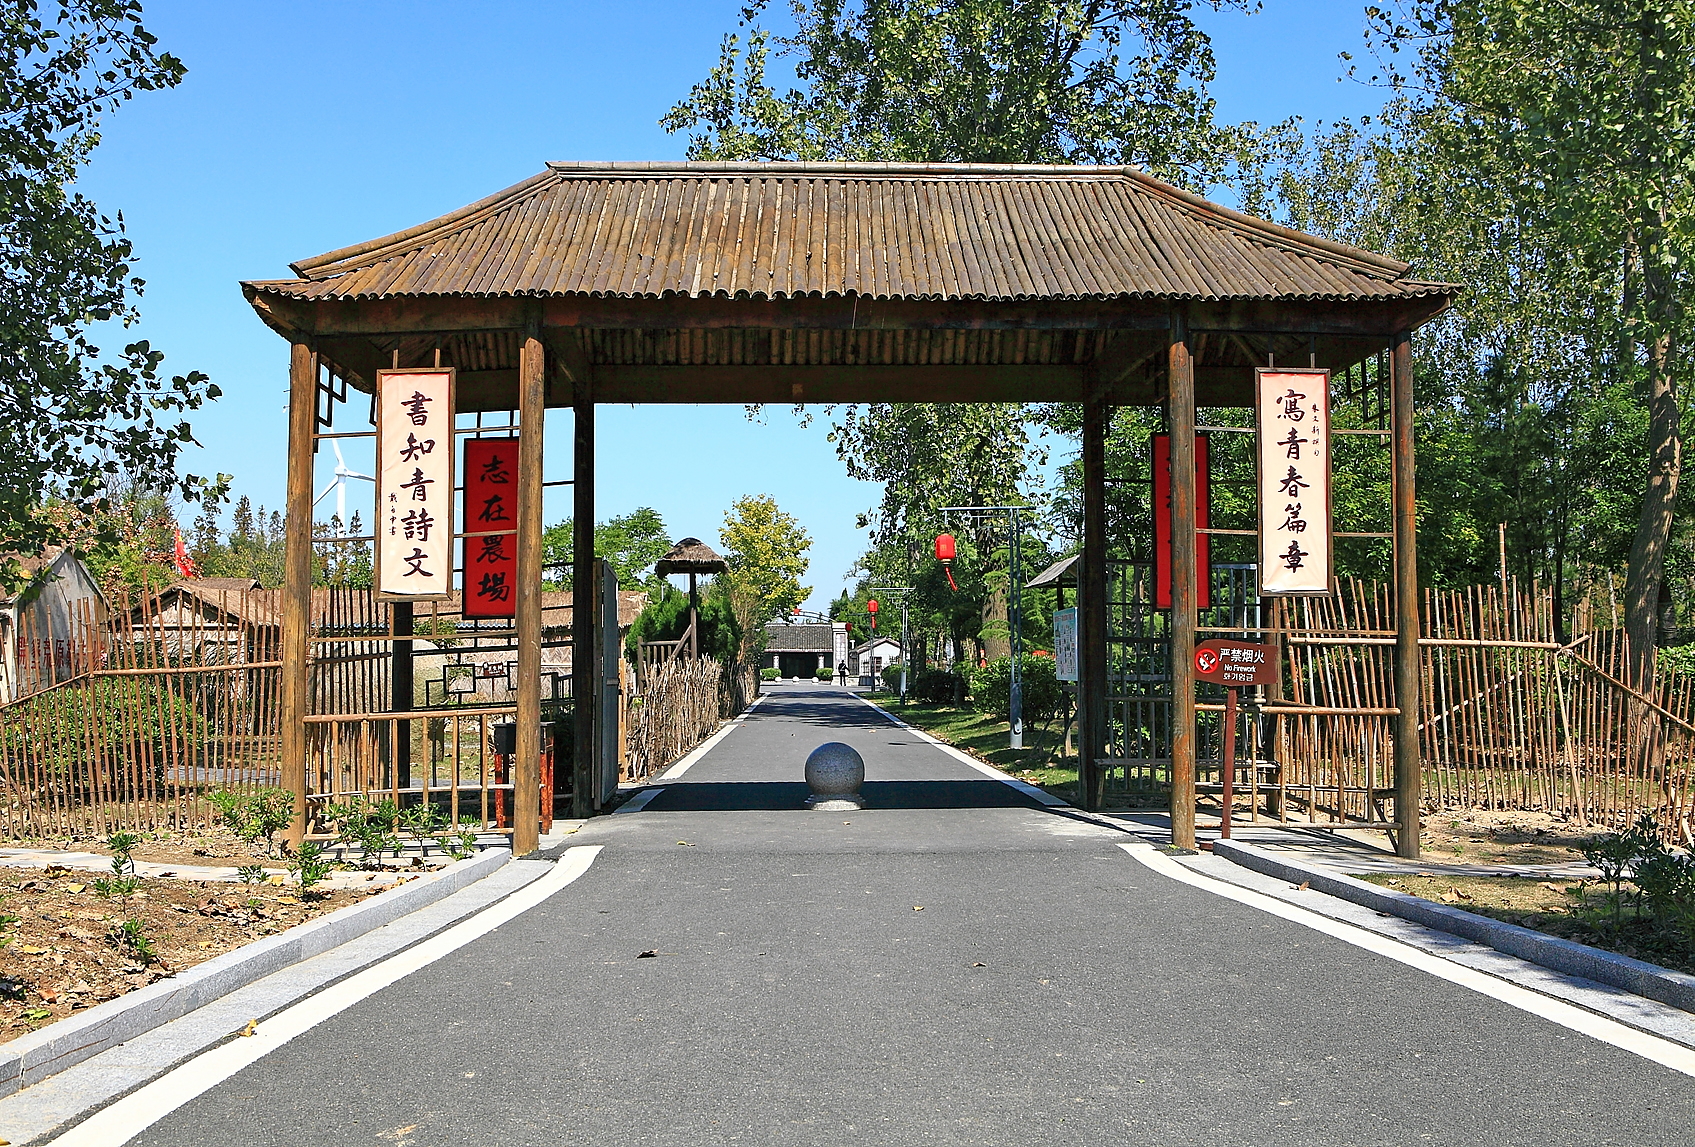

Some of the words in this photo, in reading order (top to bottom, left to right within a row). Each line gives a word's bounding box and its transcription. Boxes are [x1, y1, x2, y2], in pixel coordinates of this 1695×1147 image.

[399, 390, 436, 578] 書知青詩文
[1276, 388, 1310, 574] 寫青春篇章
[1218, 648, 1265, 664] 严禁烟火
[1224, 663, 1232, 672] No
[1233, 664, 1256, 673] Firework
